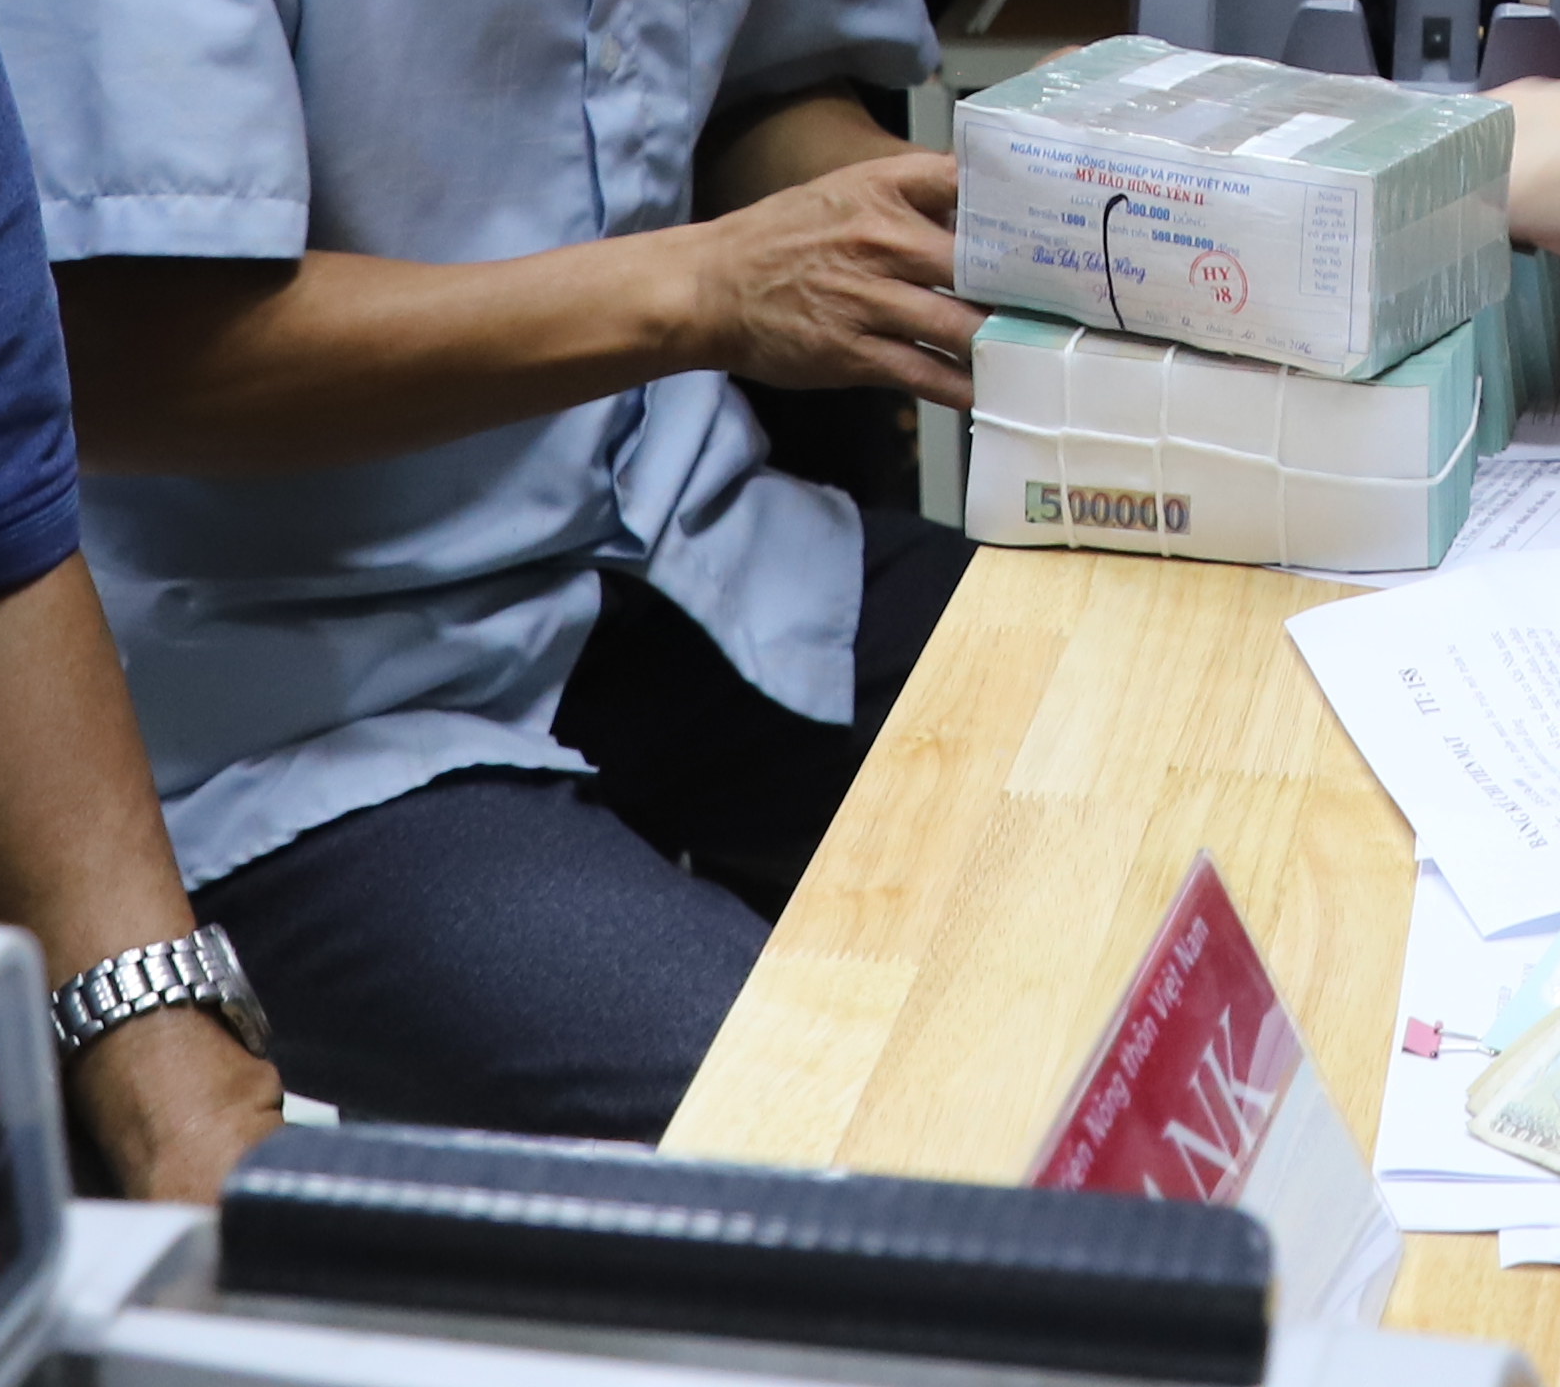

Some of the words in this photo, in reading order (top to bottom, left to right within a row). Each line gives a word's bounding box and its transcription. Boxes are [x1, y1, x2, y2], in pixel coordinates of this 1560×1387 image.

[1011, 141, 1040, 158] NGÂN
[1043, 147, 1072, 164] HÀNG
[1074, 153, 1106, 171] NÔNG
[1108, 159, 1149, 180] NGHIỆP
[1150, 167, 1164, 181] VÀ
[1167, 171, 1194, 187] PTNT
[1196, 174, 1220, 192] VIỆT
[1222, 180, 1250, 196] NAM
[1075, 166, 1095, 182] MỸ
[1127, 178, 1162, 197] HƯNG
[1166, 184, 1190, 203] YÊN
[1194, 193, 1205, 206] II
[1061, 212, 1086, 226] 1.000
[1151, 228, 1214, 250] 500.000.000
[1126, 201, 1170, 222] 500.000
[1202, 266, 1232, 282] HY
[1414, 691, 1441, 716] TT:
[1084, 1071, 1131, 1147] Nông
[1119, 1015, 1159, 1079] thôn
[1148, 963, 1185, 1020] Việt
[1173, 915, 1209, 974] Nam
[1144, 1003, 1278, 1204] NK
